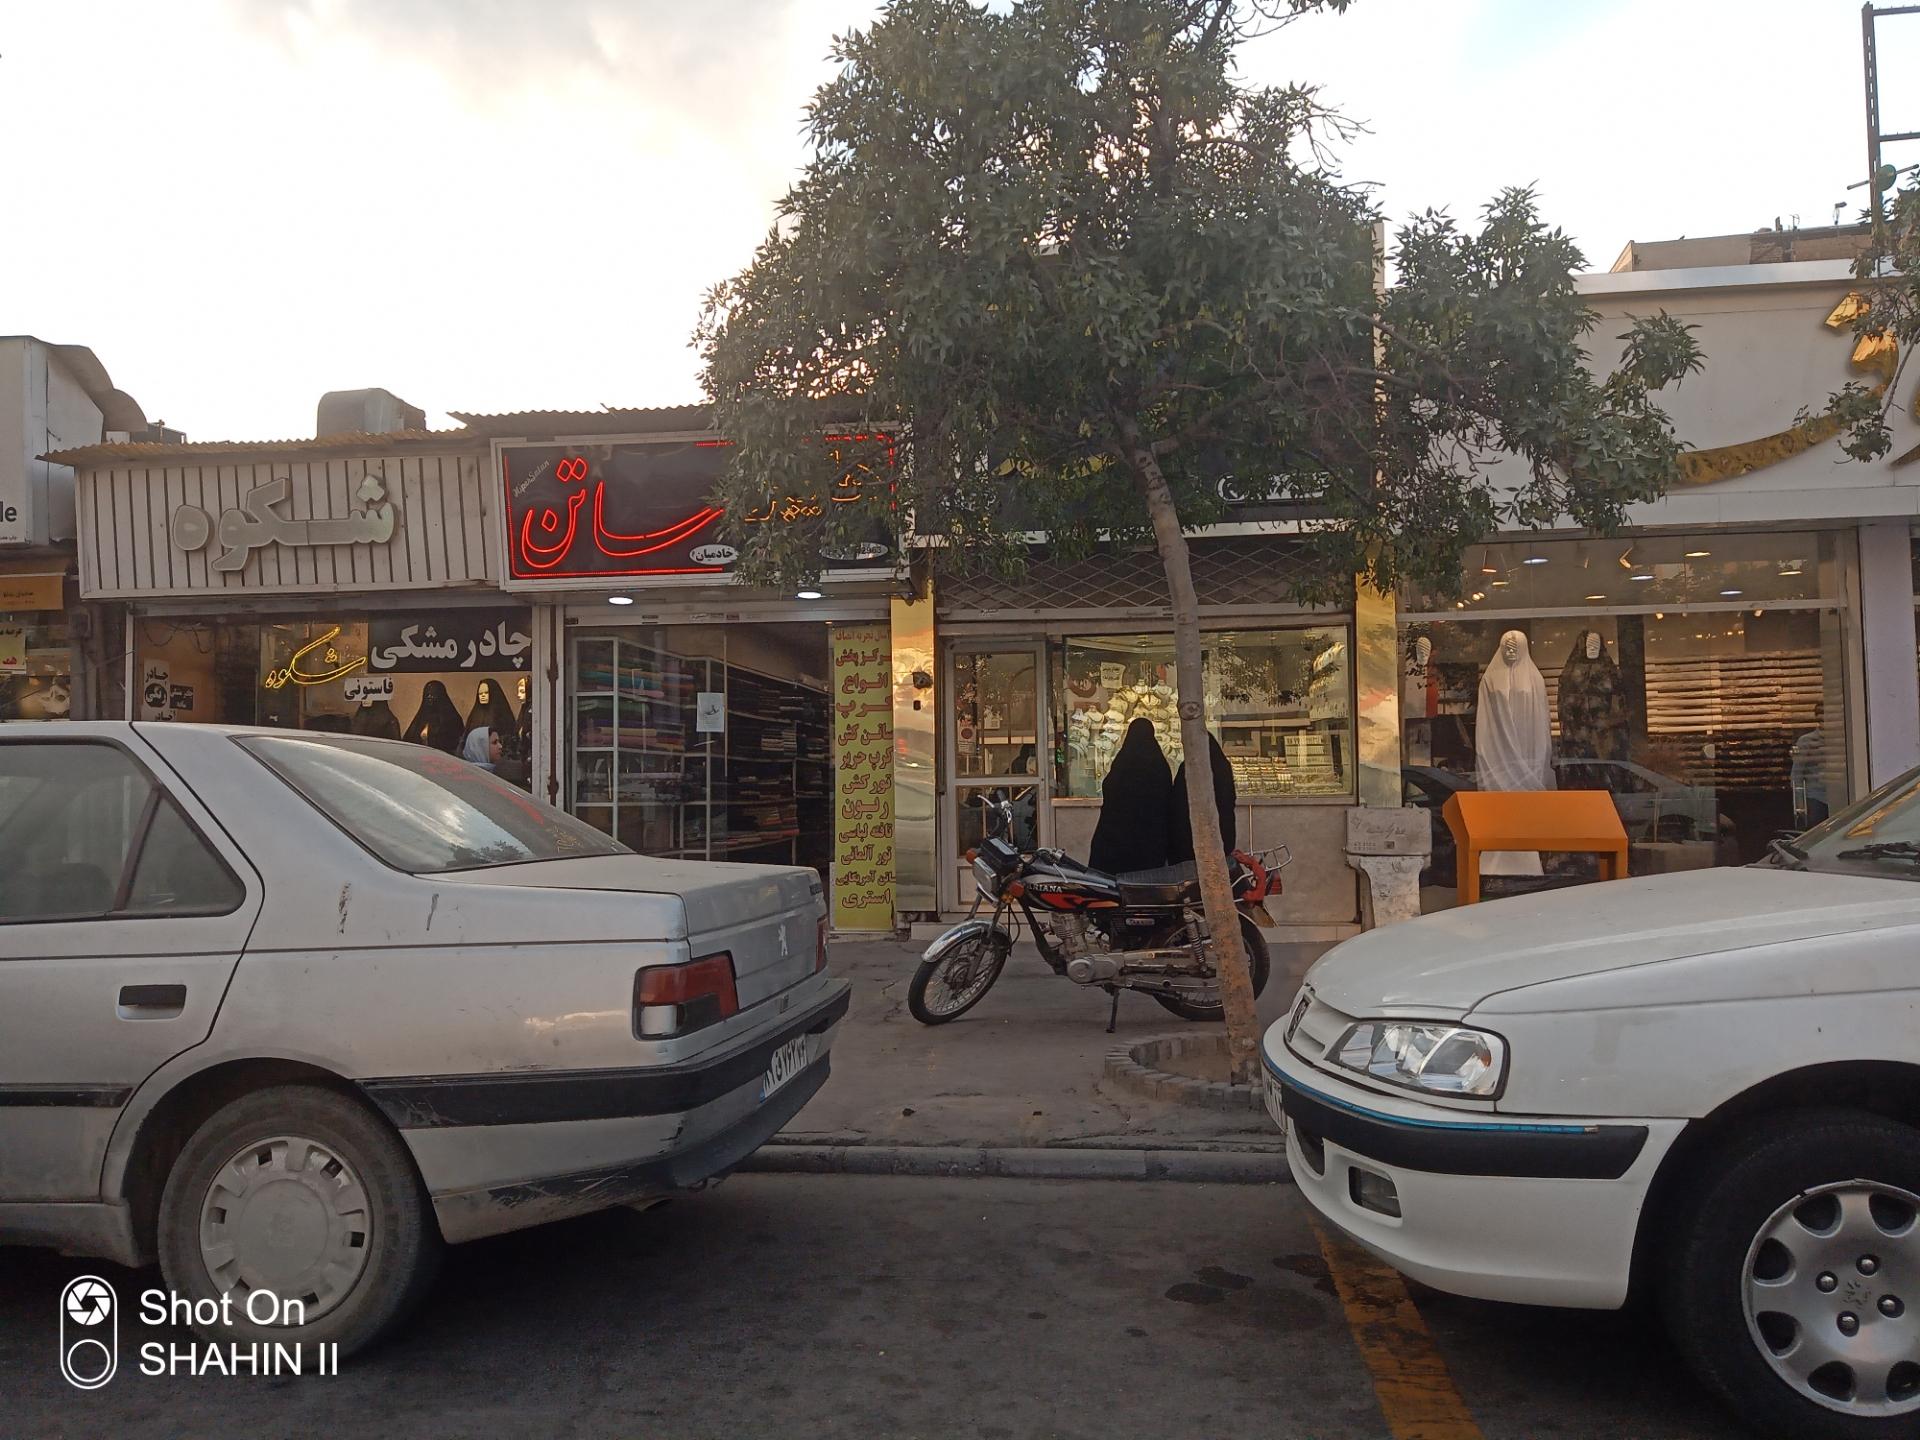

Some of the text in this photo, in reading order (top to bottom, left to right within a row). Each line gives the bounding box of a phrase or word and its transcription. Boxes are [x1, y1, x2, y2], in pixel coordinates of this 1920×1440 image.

[172, 473, 399, 572] شکوه
[371, 620, 532, 669] چادر مشکی
[265, 626, 368, 689] شکوه
[345, 678, 394, 701] فاستونی
[842, 672, 888, 694] انواع
[842, 774, 892, 794] تور کش
[839, 823, 869, 843] لباسی
[841, 844, 875, 865] آلمانی
[842, 888, 891, 908] استری
